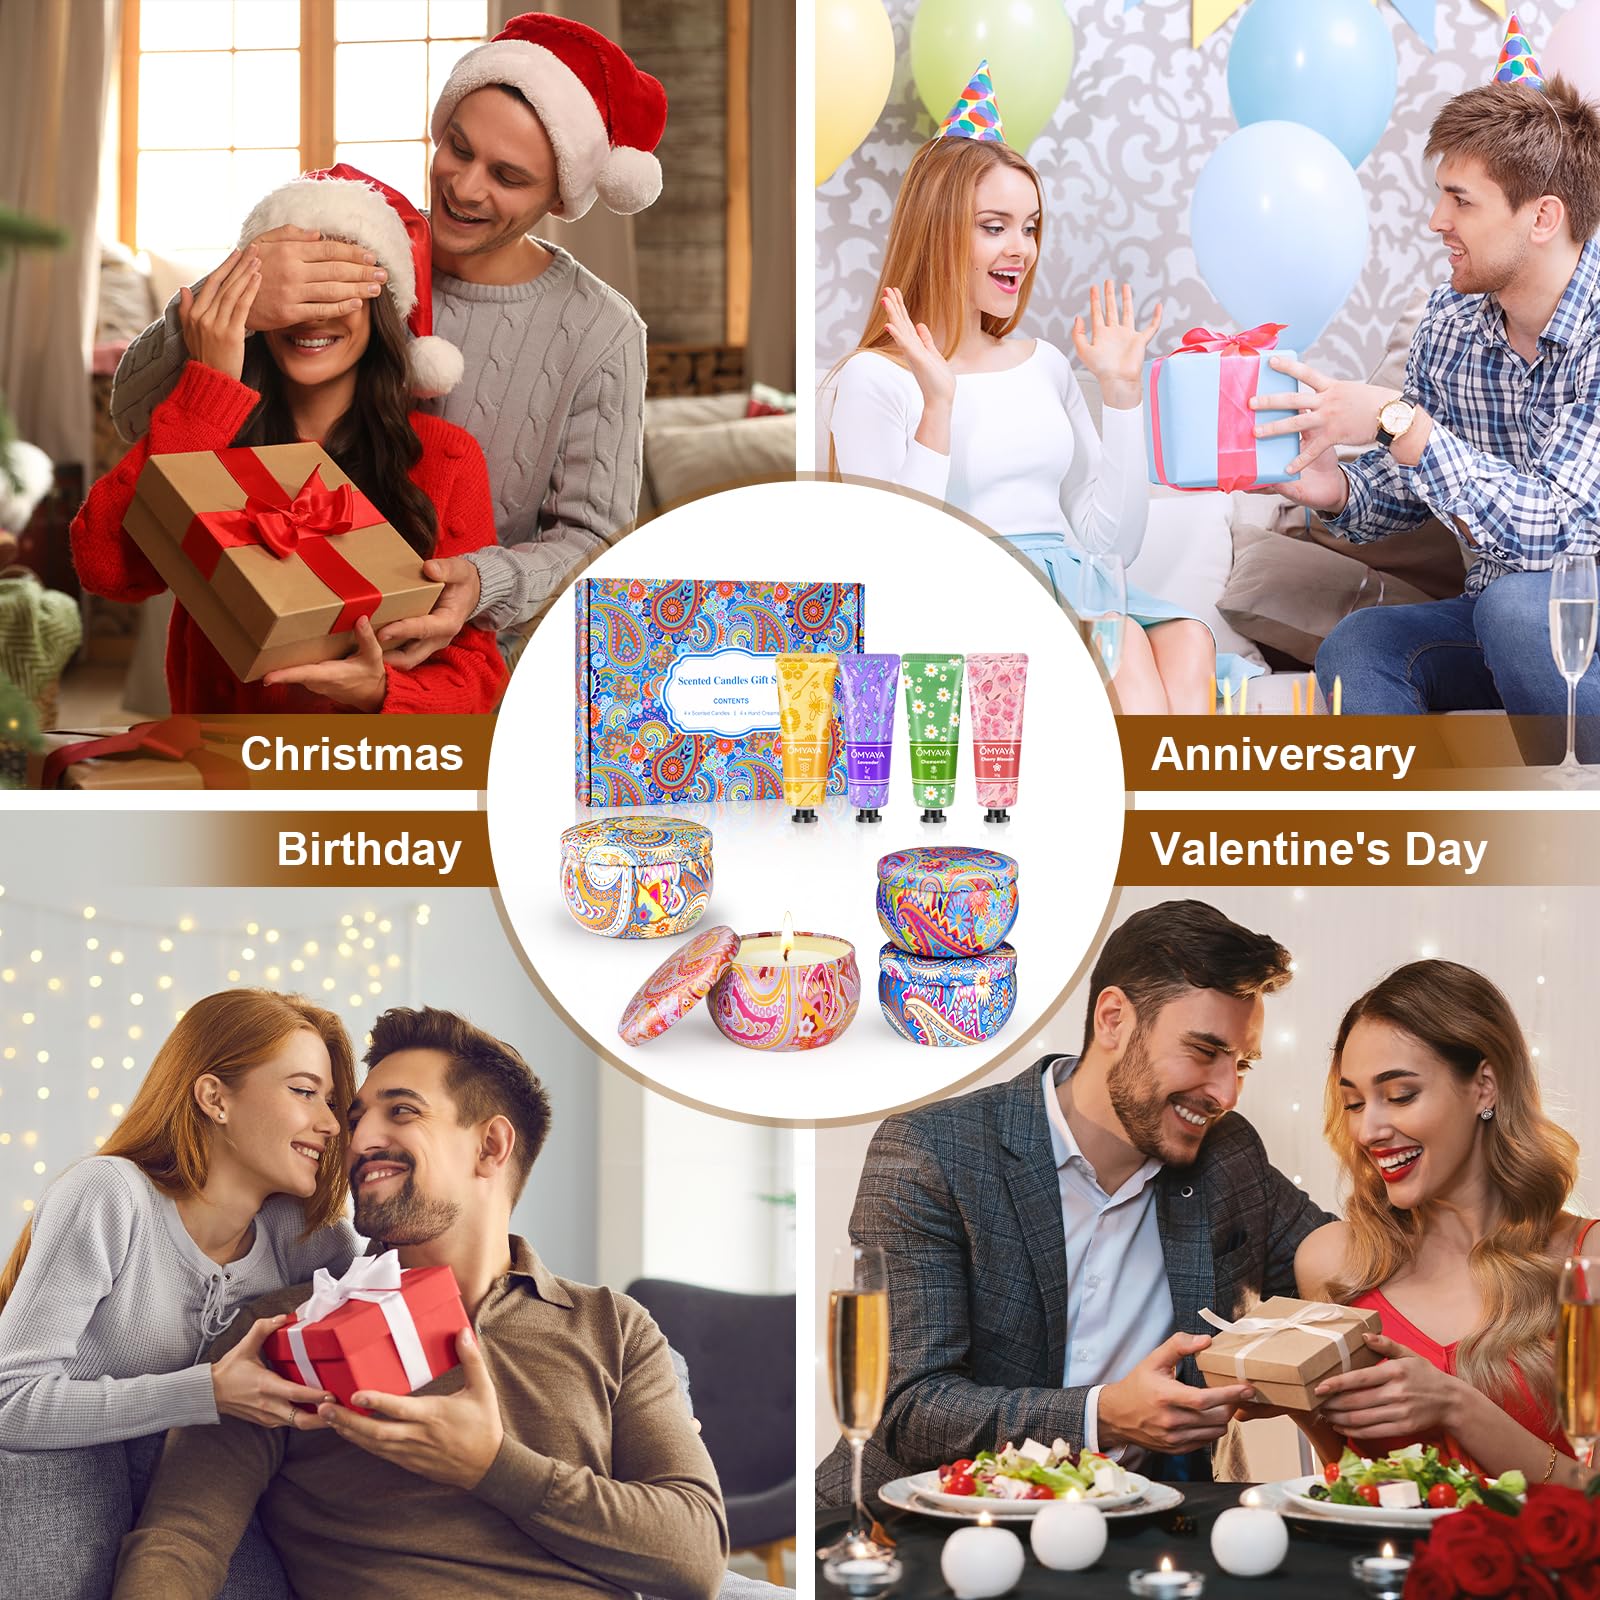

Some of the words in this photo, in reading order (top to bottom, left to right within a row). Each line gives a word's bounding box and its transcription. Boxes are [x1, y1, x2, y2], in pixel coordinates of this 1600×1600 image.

[678, 676, 711, 685] Scented
[713, 675, 749, 685] Candles
[751, 675, 769, 685] Gift
